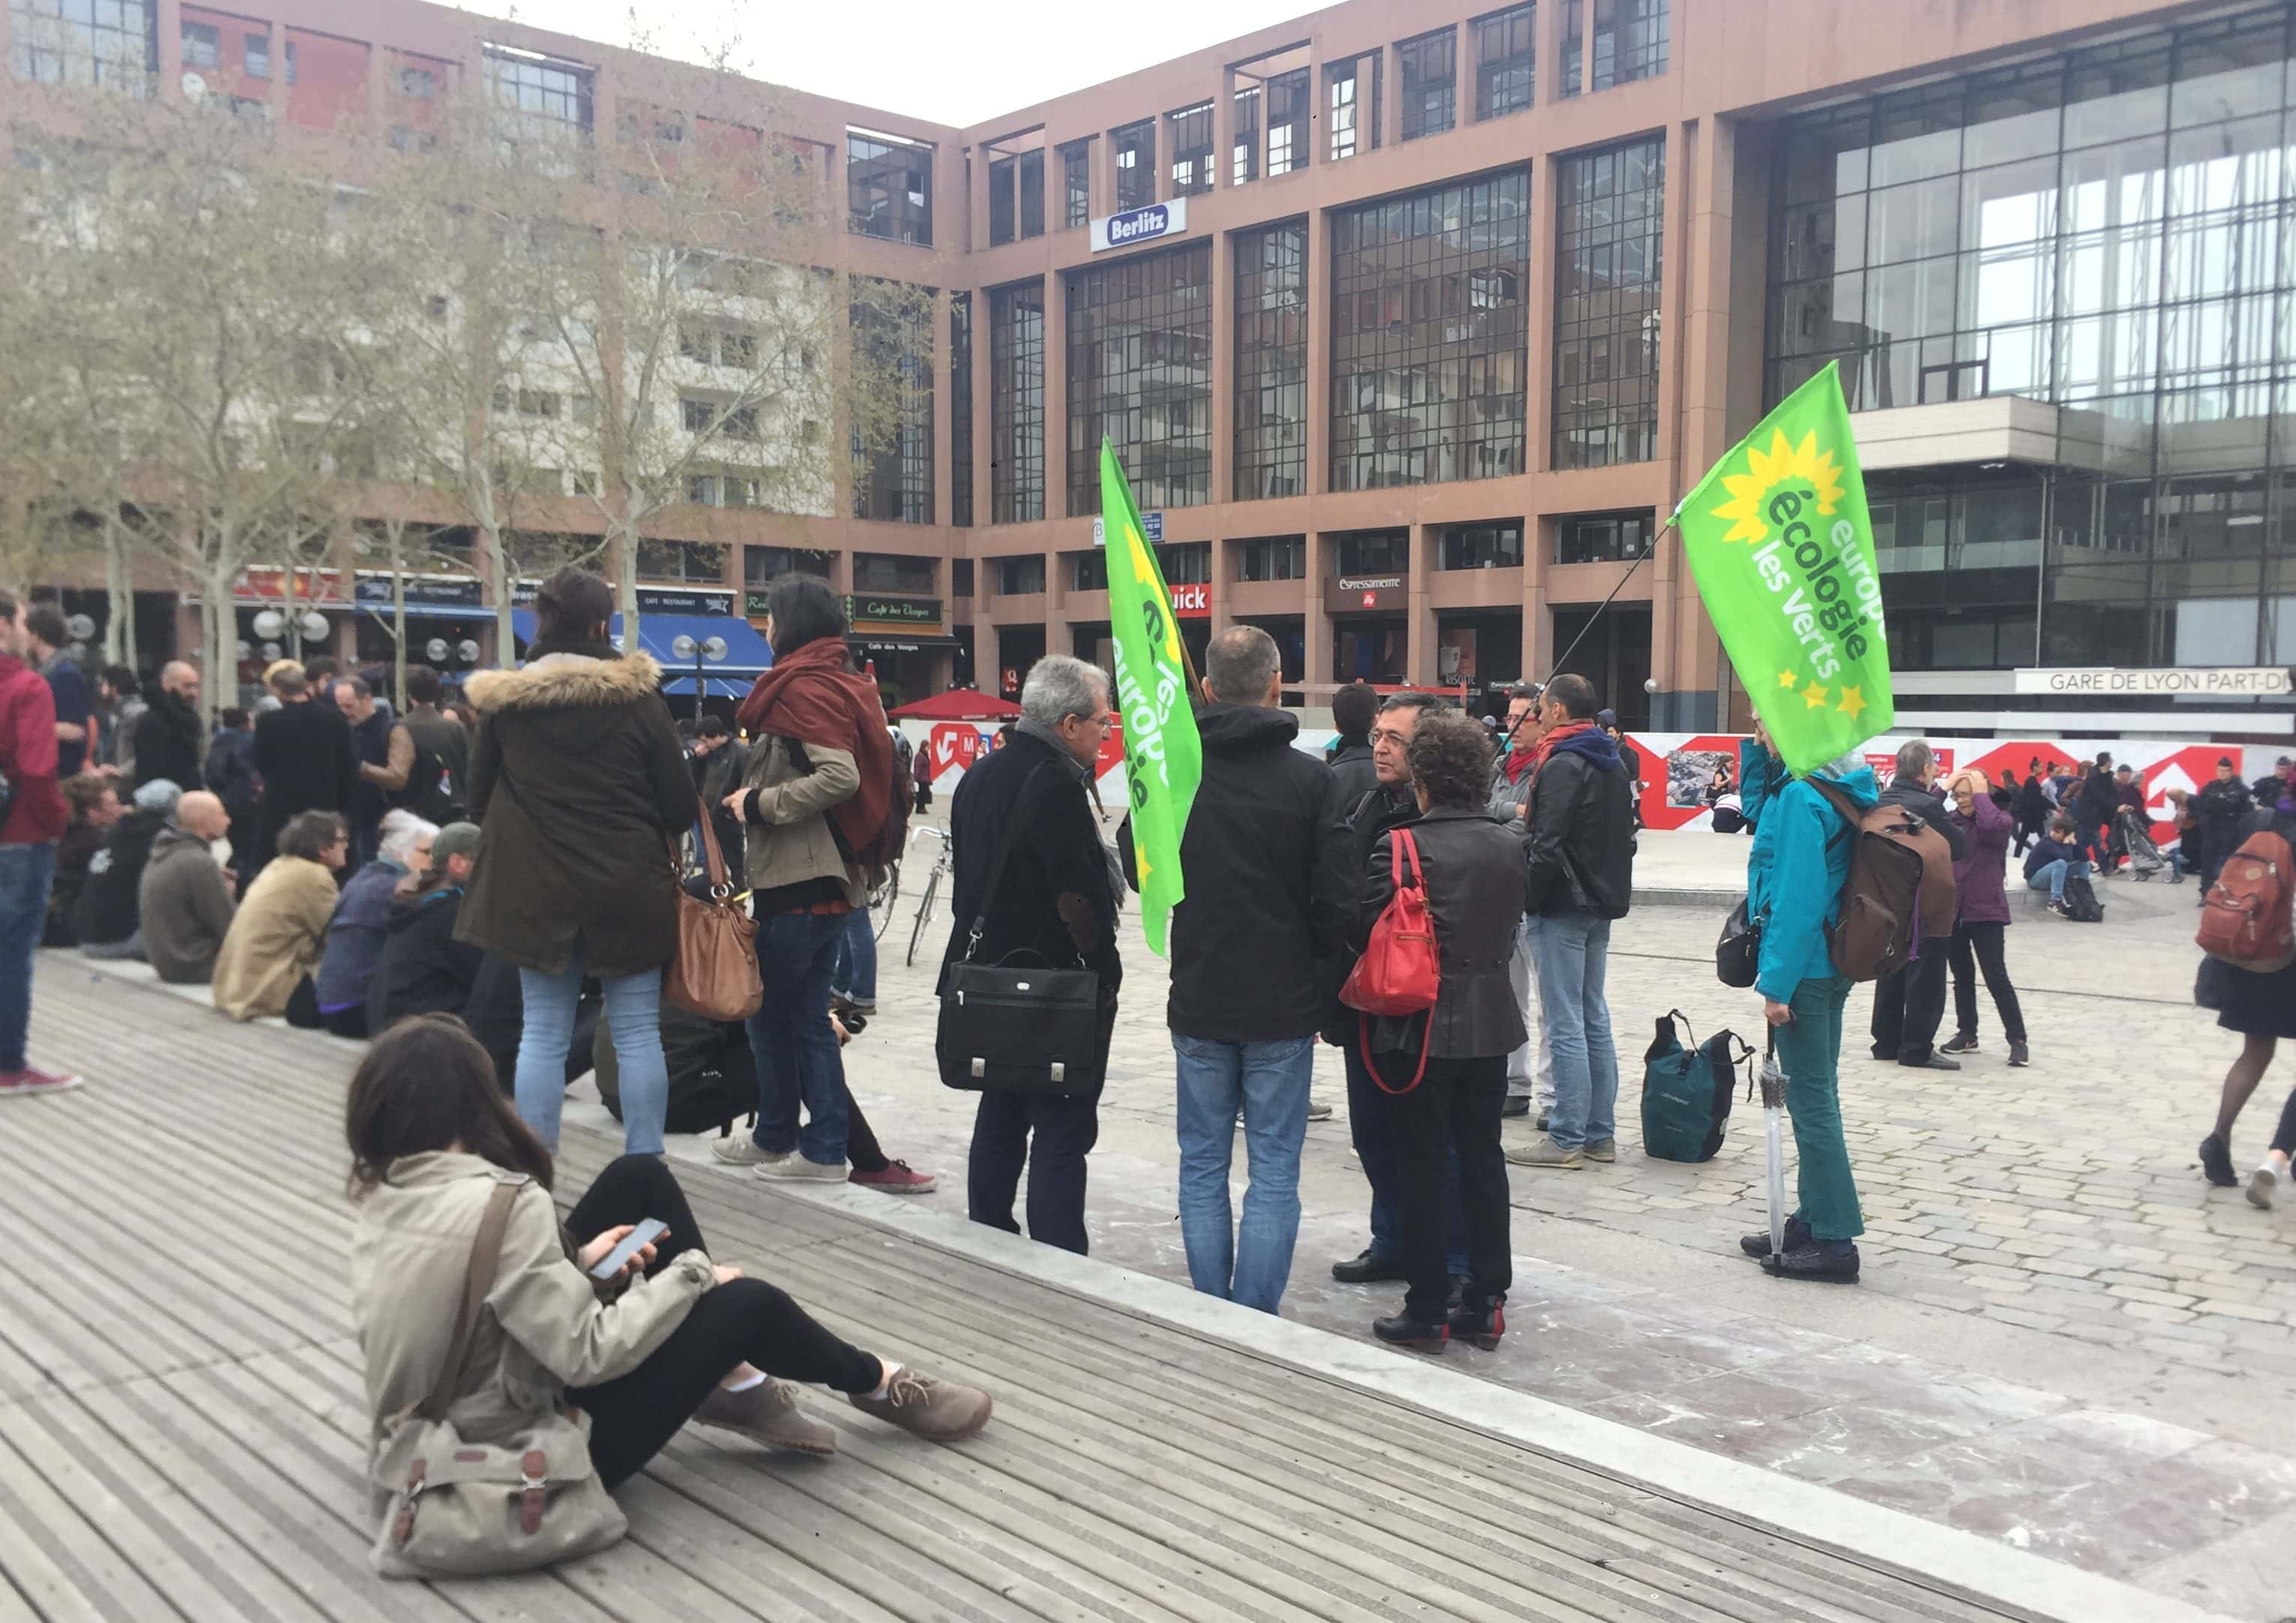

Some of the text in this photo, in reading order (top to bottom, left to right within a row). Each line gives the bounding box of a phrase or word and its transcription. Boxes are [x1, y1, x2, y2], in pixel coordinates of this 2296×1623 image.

[1112, 211, 1164, 240] Berlitz
[1769, 490, 1867, 660] écologie
[867, 602, 888, 616] Café
[1173, 585, 1206, 609] uick
[1752, 539, 1842, 680] les Verts
[2050, 672, 2289, 690] GARE DE LYON PART-DI
[1112, 636, 1169, 787] europ
